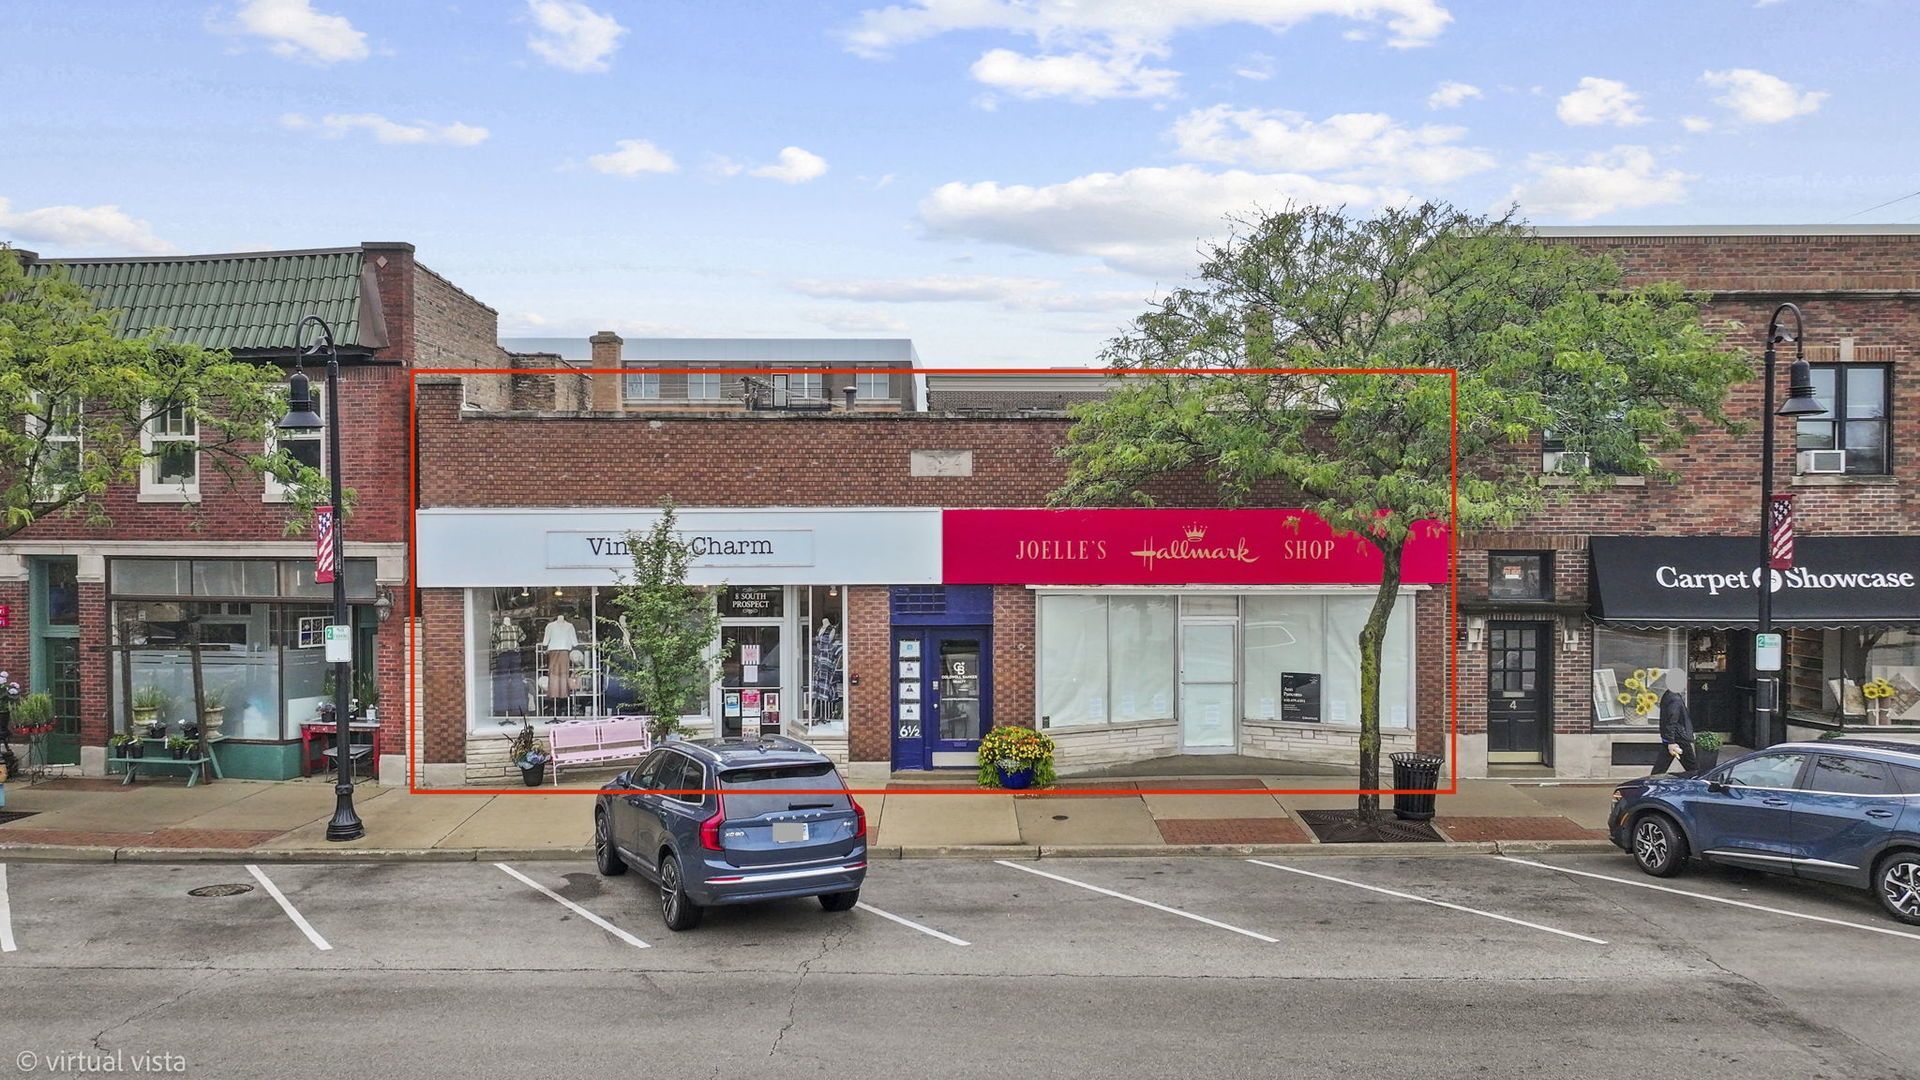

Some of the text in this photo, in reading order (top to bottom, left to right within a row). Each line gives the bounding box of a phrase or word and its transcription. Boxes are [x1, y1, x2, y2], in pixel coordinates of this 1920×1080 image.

[691, 537, 774, 556] Charm
[1015, 536, 1336, 571] JOELLE'S Hallmark SHOP
[1655, 565, 1916, 595] Carpet Showcase
[740, 592, 767, 600] SOUTH
[732, 600, 770, 608] PROSPECT
[327, 628, 333, 639] 2
[1758, 636, 1765, 646] 2
[1509, 700, 1517, 710] 4
[766, 813, 821, 822] VOLVO
